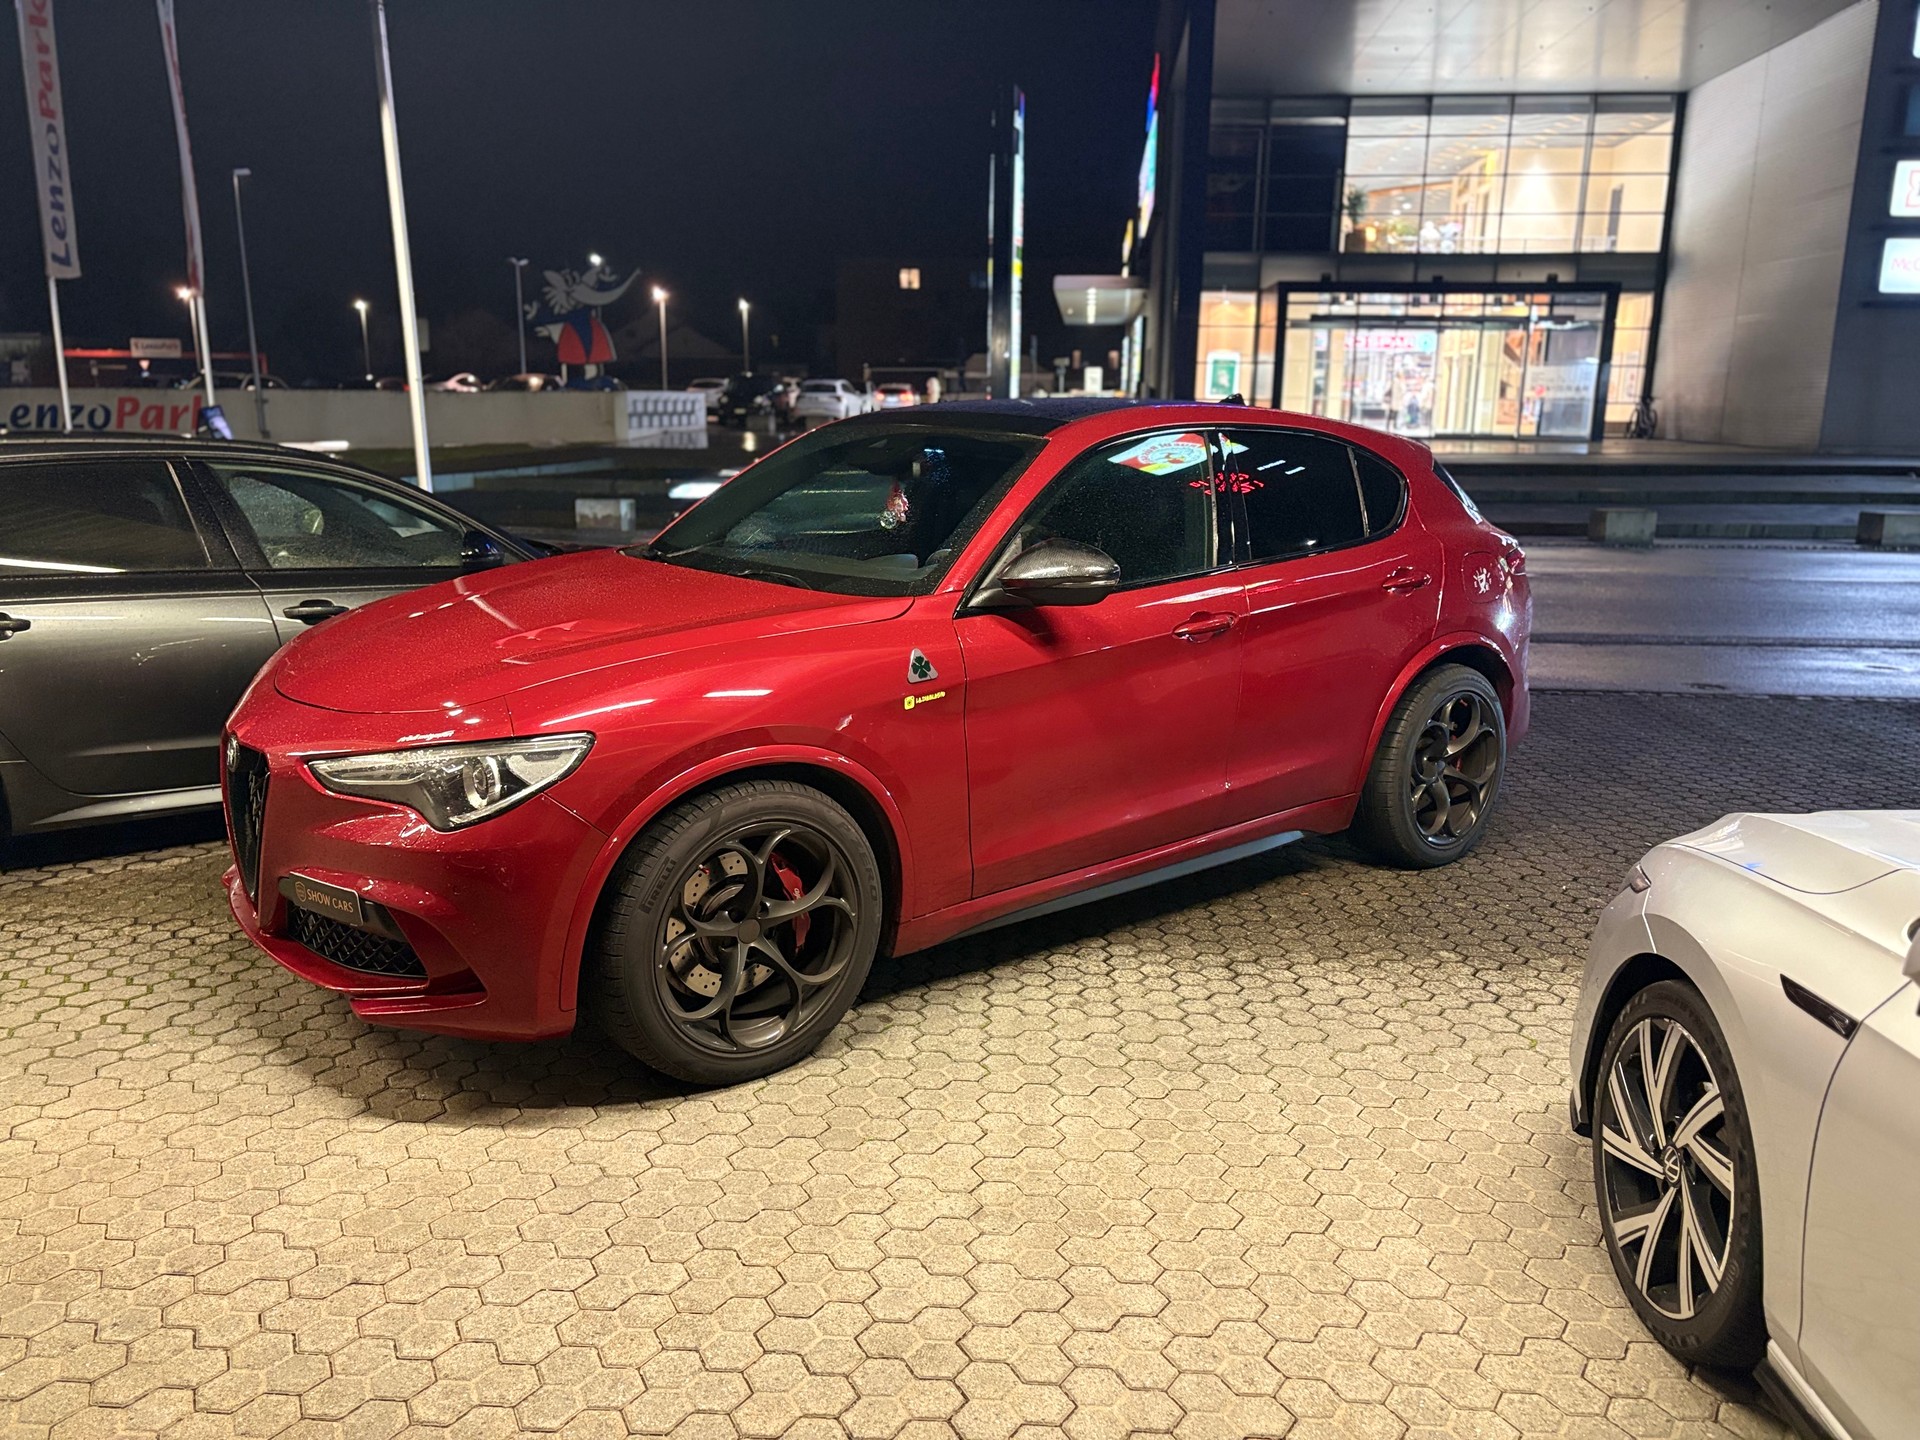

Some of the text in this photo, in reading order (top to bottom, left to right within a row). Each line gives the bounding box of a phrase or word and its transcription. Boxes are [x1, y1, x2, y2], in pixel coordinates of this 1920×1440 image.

[28, 0, 73, 269] LenzoPark
[306, 888, 331, 906] SHOW
[332, 897, 354, 913] CARS
[638, 855, 678, 914] PIRELLI
